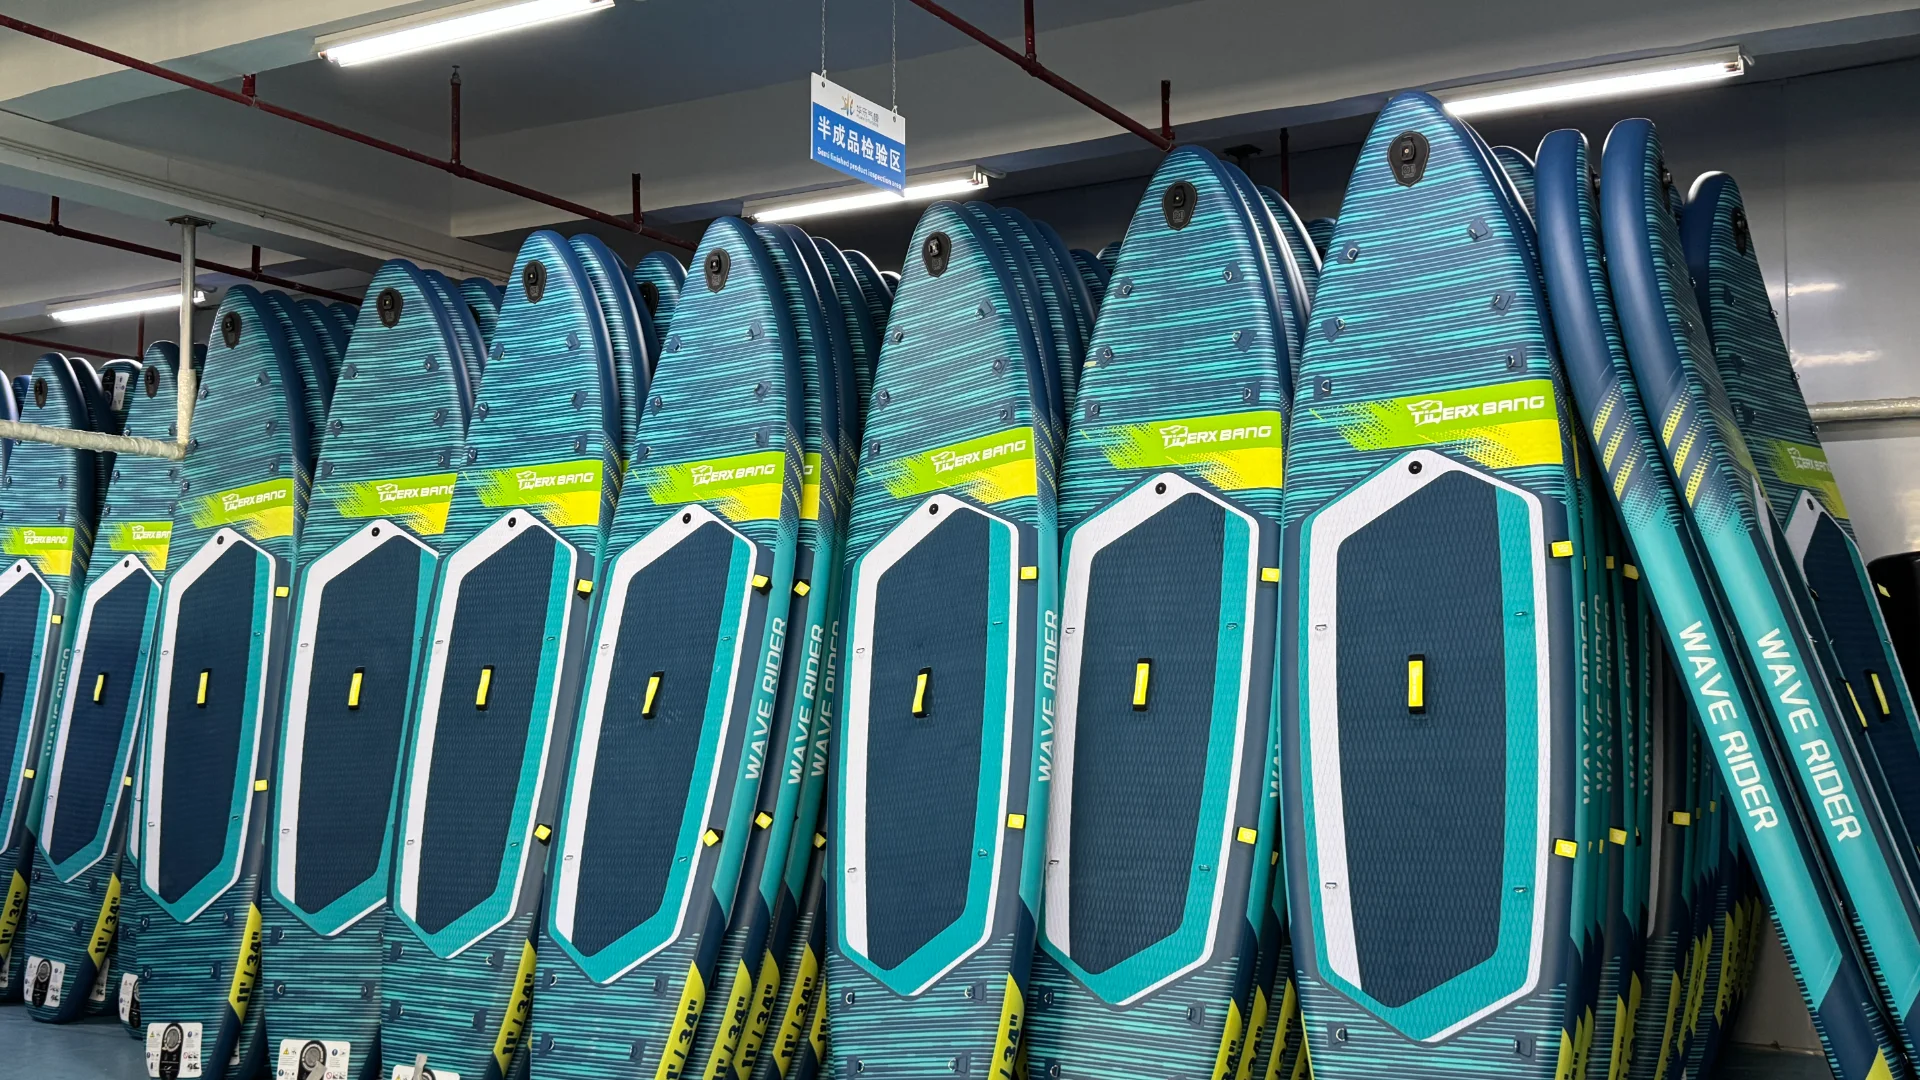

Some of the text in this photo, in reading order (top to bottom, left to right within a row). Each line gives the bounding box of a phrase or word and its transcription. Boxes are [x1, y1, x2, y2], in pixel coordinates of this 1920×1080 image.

[817, 147, 901, 189] Semi finished product inspection area
[818, 116, 901, 172] 半成品检验区
[1407, 396, 1545, 427] TIGERX BANG
[932, 440, 1026, 474] TIGERX BANG
[1160, 425, 1271, 449] TIGERX BANG
[378, 485, 420, 502] TIGERX
[516, 472, 594, 490] TIGERX BANG
[692, 464, 775, 486] TIGERX BANG
[223, 490, 286, 511] TIGERX BANG
[745, 617, 785, 779] WAVE RIDER
[788, 624, 824, 784] WAVE RIDER
[1038, 610, 1058, 782] WAVE RIDER
[1679, 621, 1778, 832] WAVE RIDER
[1757, 628, 1861, 842] WAVE RIDER
[9, 892, 23, 917] 34"
[95, 937, 108, 953] 11'
[106, 897, 120, 924] 34"
[237, 982, 250, 1003] 11'
[246, 932, 261, 966] 34"
[502, 1031, 518, 1055] 11'
[517, 973, 534, 1014] 34"
[679, 999, 700, 1045] 34"
[728, 996, 746, 1041] 34"
[742, 1043, 755, 1068] 11'
[757, 984, 773, 1025] 34"
[781, 1034, 796, 1058] 11'
[796, 976, 812, 1017] 34"
[1004, 1014, 1021, 1063] 34"
